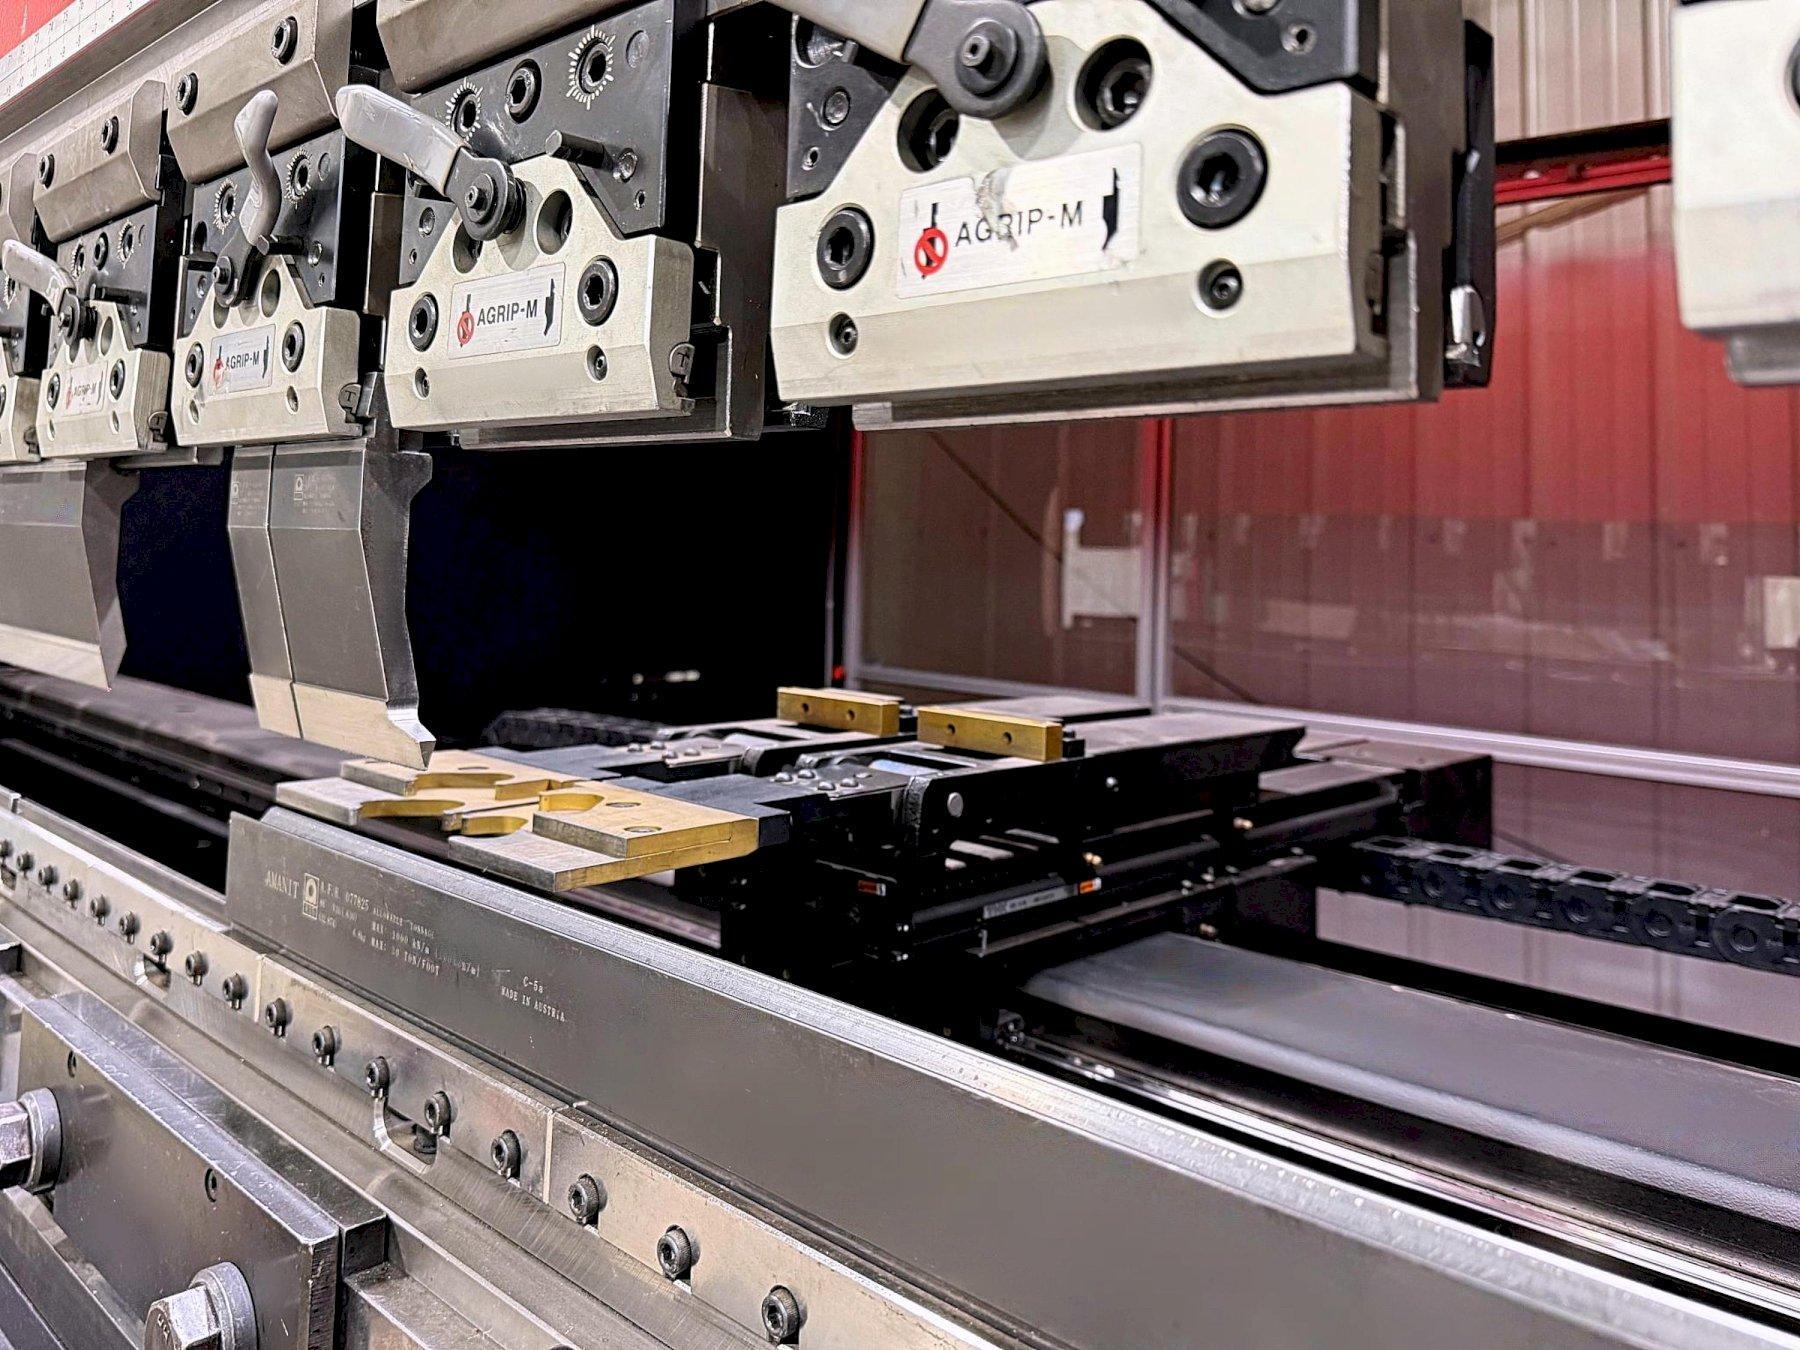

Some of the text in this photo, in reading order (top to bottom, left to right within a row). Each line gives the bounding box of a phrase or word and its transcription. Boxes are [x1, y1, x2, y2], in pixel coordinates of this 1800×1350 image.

[477, 299, 538, 327] AGRIP-M
[501, 986, 565, 1022] MADE IN AUSTRIA
